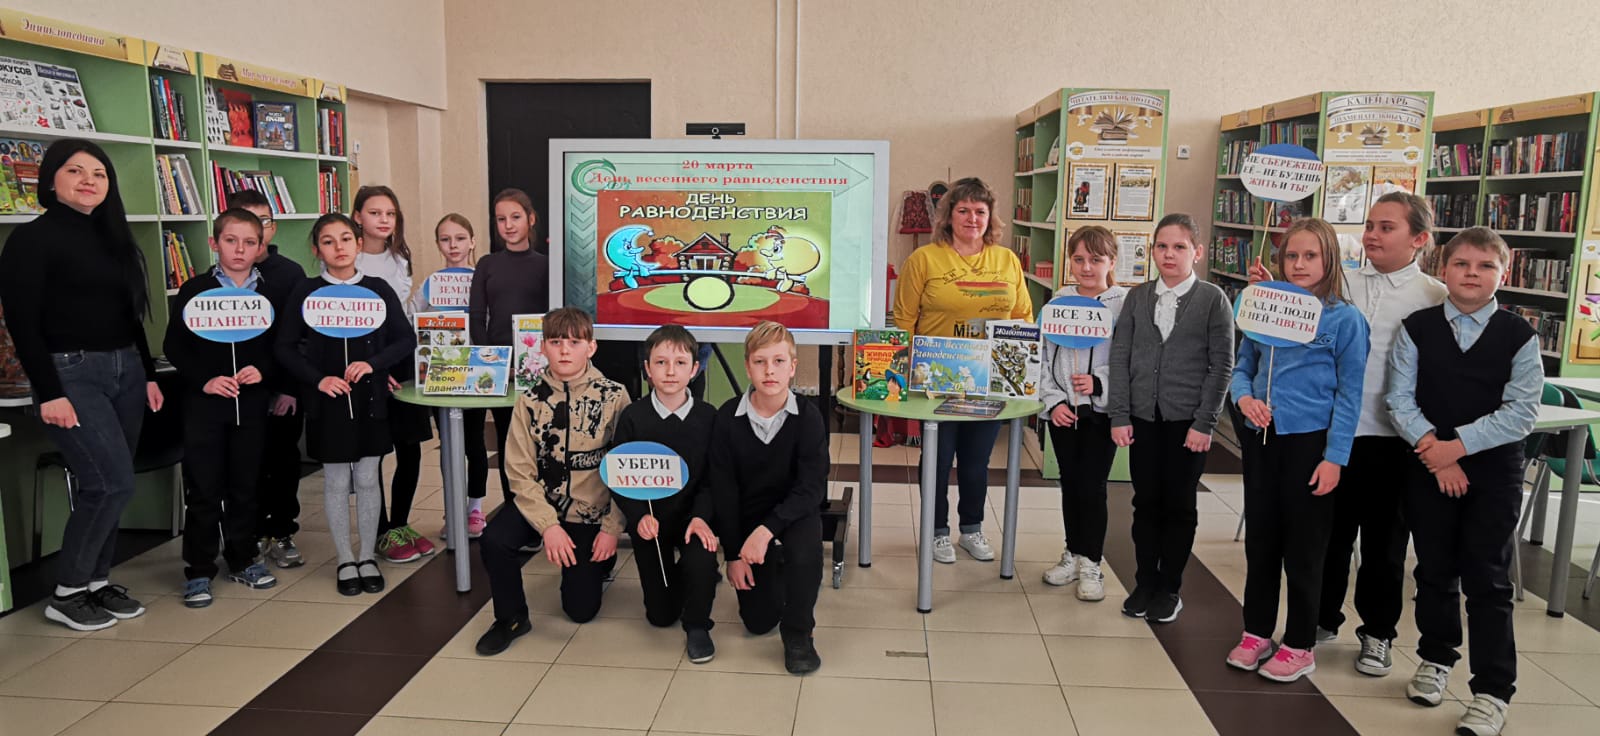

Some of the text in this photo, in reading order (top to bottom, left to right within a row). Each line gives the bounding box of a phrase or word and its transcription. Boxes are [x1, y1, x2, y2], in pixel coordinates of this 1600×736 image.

[682, 160, 754, 172] 20 марта
[1261, 157, 1325, 172] СБЕРЕЖЕШЬ
[636, 175, 718, 184] весеннего
[723, 176, 848, 186] равноденствия
[1263, 168, 1277, 177] НЕ
[1278, 170, 1321, 183] БУДЕШЬ
[1248, 178, 1309, 193] ЖИТЬ И ТЫ!
[685, 193, 737, 206] ДЕНЬ
[619, 205, 808, 221] РАВНОДЕНСТВИЯ
[439, 286, 471, 294] ЗЕМЛ
[432, 297, 468, 305] ЦВЕТА
[1252, 288, 1303, 306] ПРИРОДА
[194, 299, 262, 311] ЧИСТАЯ
[306, 300, 385, 312] ПОСАДИТЕ
[1052, 308, 1103, 321] ВСЕ ЗА
[1239, 309, 1246, 318] В
[1248, 311, 1269, 323] НЕЙ
[1269, 304, 1278, 313] И
[1279, 306, 1316, 321] ЛЮДИ
[188, 315, 269, 328] ПЛАНЕТА
[315, 315, 376, 327] ДЕРЕВО
[424, 319, 458, 328] Земля
[994, 327, 1038, 338] Животные
[1042, 323, 1110, 337] ЧИСТОТУ
[617, 457, 670, 470] УБЕРИ
[616, 475, 675, 487] МУСОР
